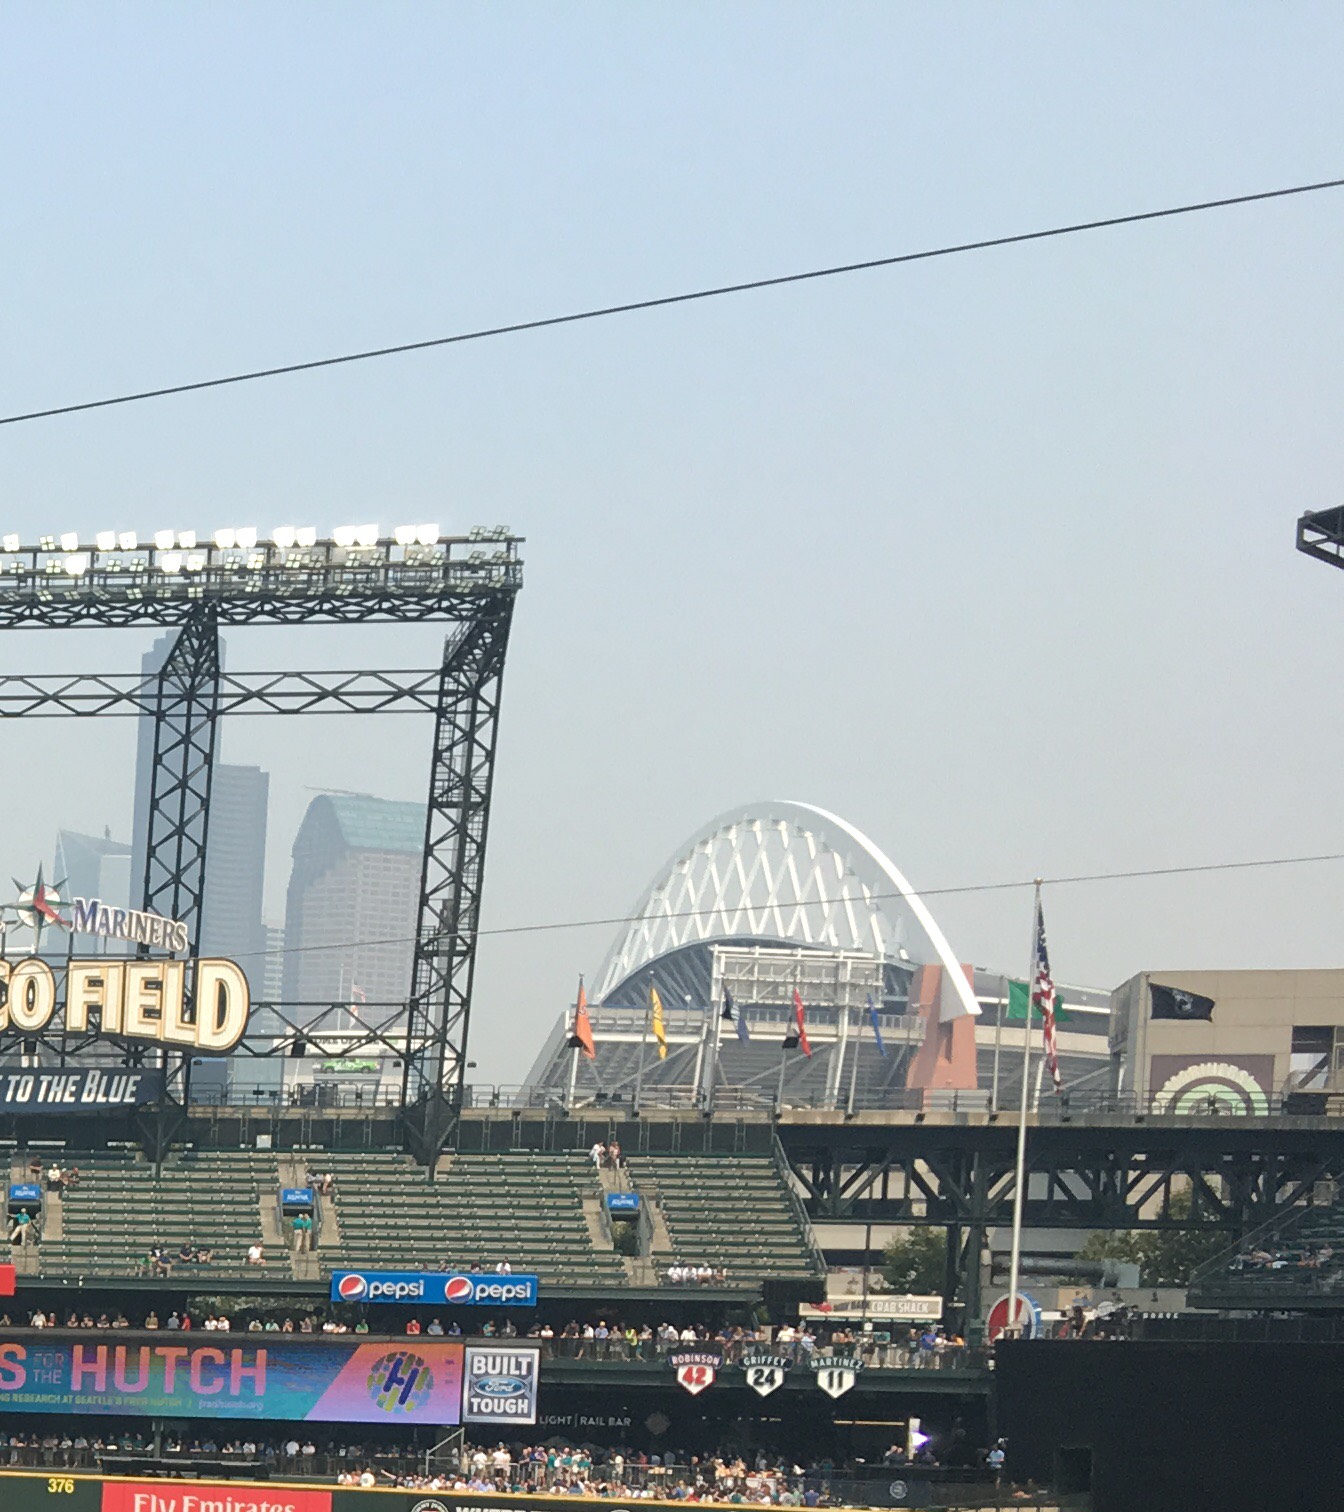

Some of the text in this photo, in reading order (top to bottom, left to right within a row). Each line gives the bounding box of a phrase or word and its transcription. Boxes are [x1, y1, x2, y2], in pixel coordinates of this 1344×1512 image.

[71, 897, 189, 952] MARINERS
[66, 957, 250, 1055] FIELD
[5, 1075, 35, 1103] TO
[37, 1075, 81, 1103] THE
[81, 1069, 142, 1103] BLUE
[369, 1279, 425, 1299] pepsi
[475, 1281, 532, 1301] pepsi
[472, 1355, 532, 1376] BUILT
[671, 1354, 721, 1366] ROBINSON
[743, 1355, 787, 1368] GRIFFEY
[810, 1356, 862, 1370] MARTINEZ
[32, 1368, 63, 1385] THE
[70, 1344, 268, 1397] HUTCH
[682, 1369, 707, 1386] 42
[752, 1369, 776, 1387] 24
[484, 1379, 516, 1393] Ford
[827, 1370, 845, 1391] 11
[470, 1398, 529, 1414] TOUGH
[539, 1415, 632, 1427] LIGHT RAIL BAR
[47, 1478, 75, 1495] 376
